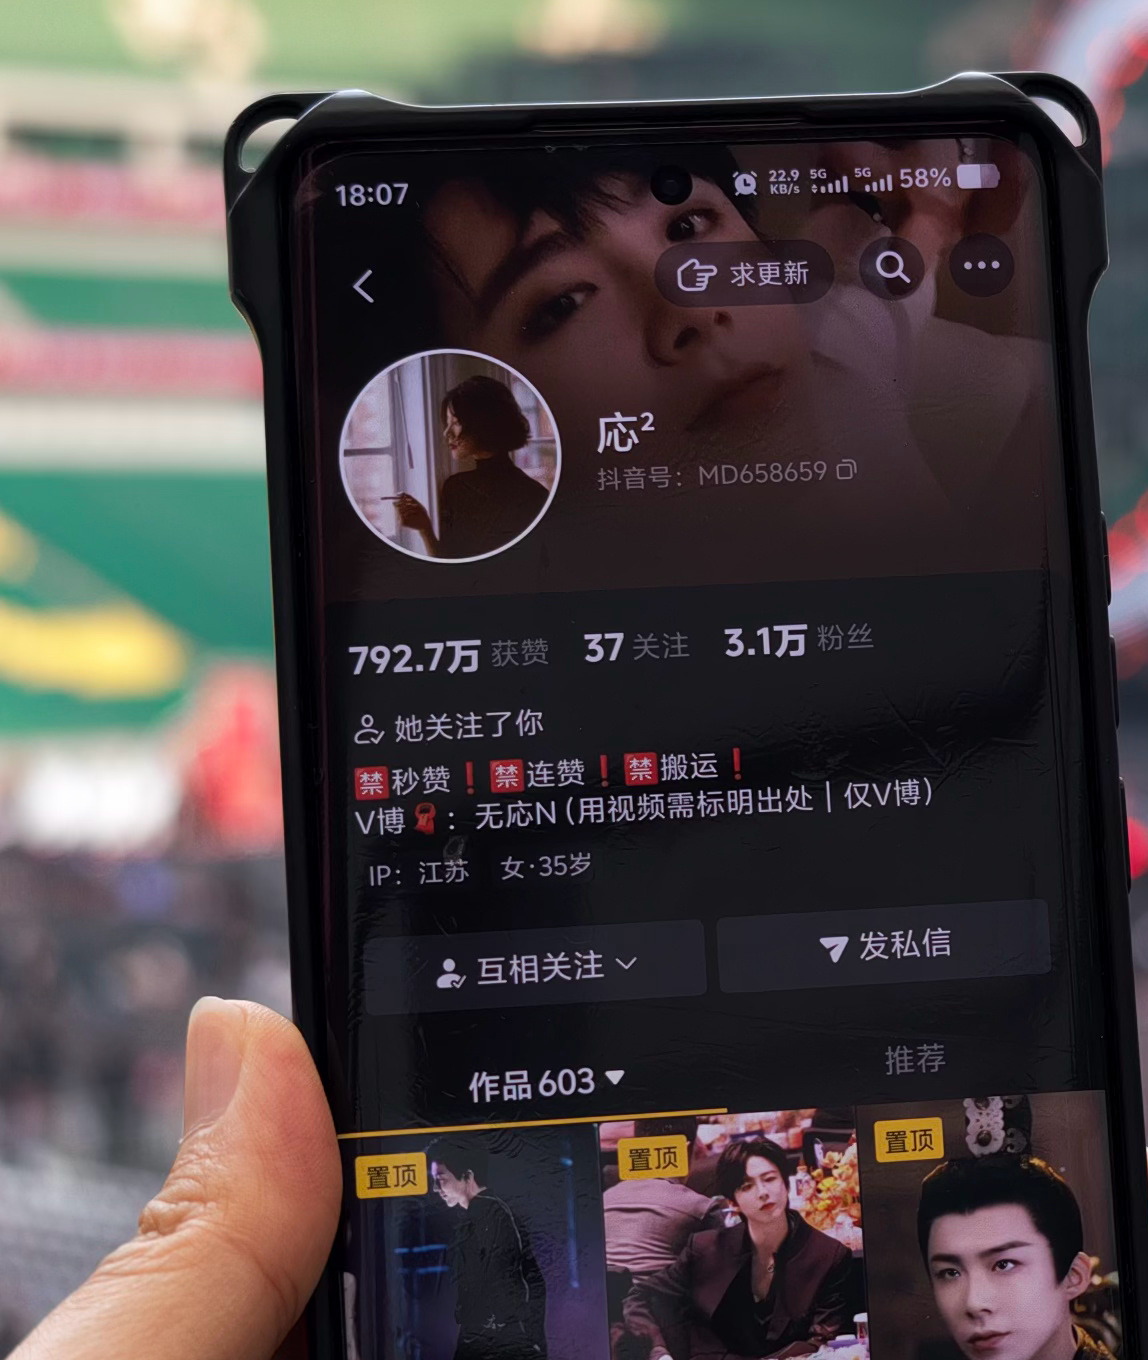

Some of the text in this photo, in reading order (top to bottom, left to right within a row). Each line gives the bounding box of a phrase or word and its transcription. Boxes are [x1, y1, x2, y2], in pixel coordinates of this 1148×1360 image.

[768, 169, 800, 182] 22.9
[809, 168, 828, 180] 5G
[854, 167, 872, 178] 5G
[899, 167, 952, 189] 58%
[334, 182, 408, 208] 18:07
[769, 183, 801, 195] KB/s
[729, 259, 810, 288] 求更新
[583, 632, 690, 663] 37 关注
[724, 622, 874, 659] 3.1万 粉丝
[348, 638, 549, 676] 792.7万 获赞
[395, 708, 543, 744] 她关注了你
[859, 928, 951, 961] 发私信
[476, 950, 605, 986] 互相关注
[884, 1043, 946, 1076] 推荐
[884, 1127, 936, 1156] 置顶
[627, 1143, 679, 1173] 置顶
[365, 1161, 419, 1191] 置顶
